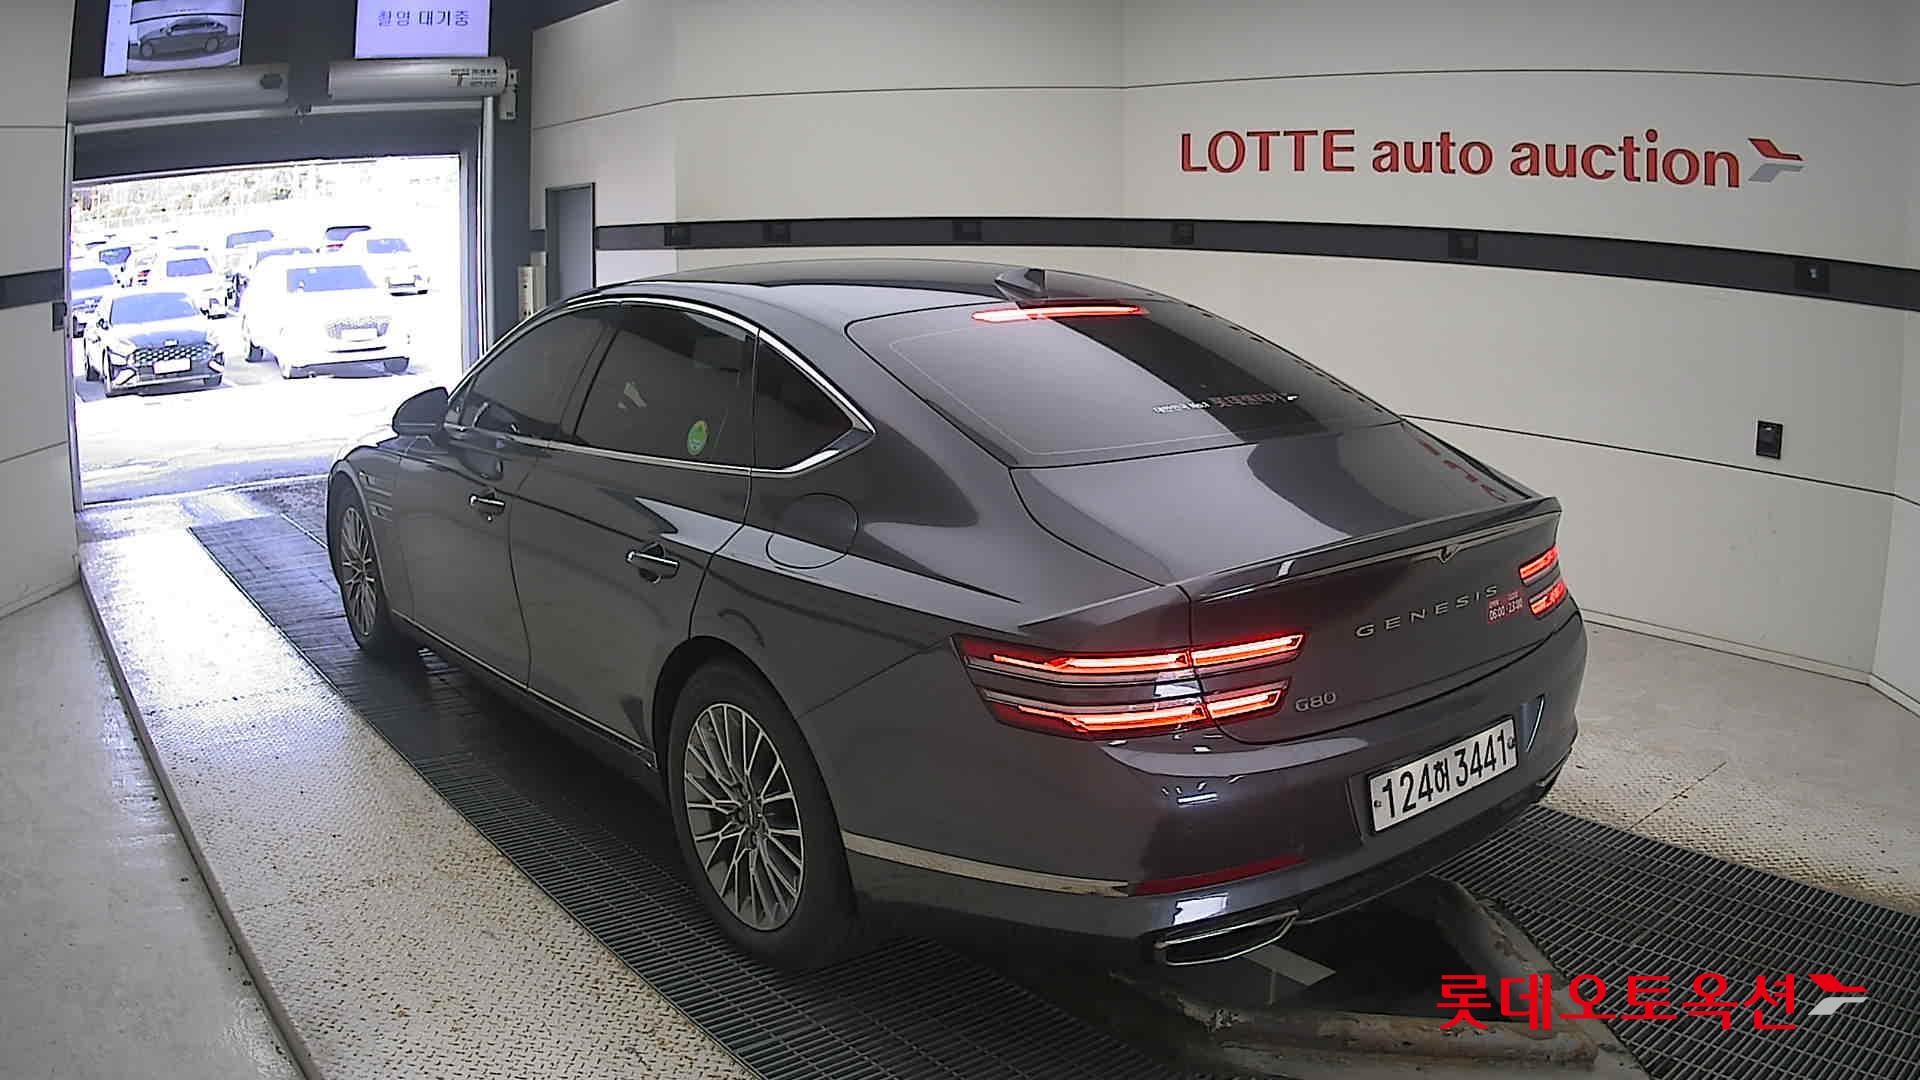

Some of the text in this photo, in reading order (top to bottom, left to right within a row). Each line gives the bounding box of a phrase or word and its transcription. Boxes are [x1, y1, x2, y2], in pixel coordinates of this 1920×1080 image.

[419, 9, 471, 27] 대기중
[1180, 128, 1740, 188] LOTTE auto auction
[1355, 585, 1497, 638] GENESIS
[1295, 691, 1337, 712] G80
[1382, 729, 1508, 818] 124허 3441
